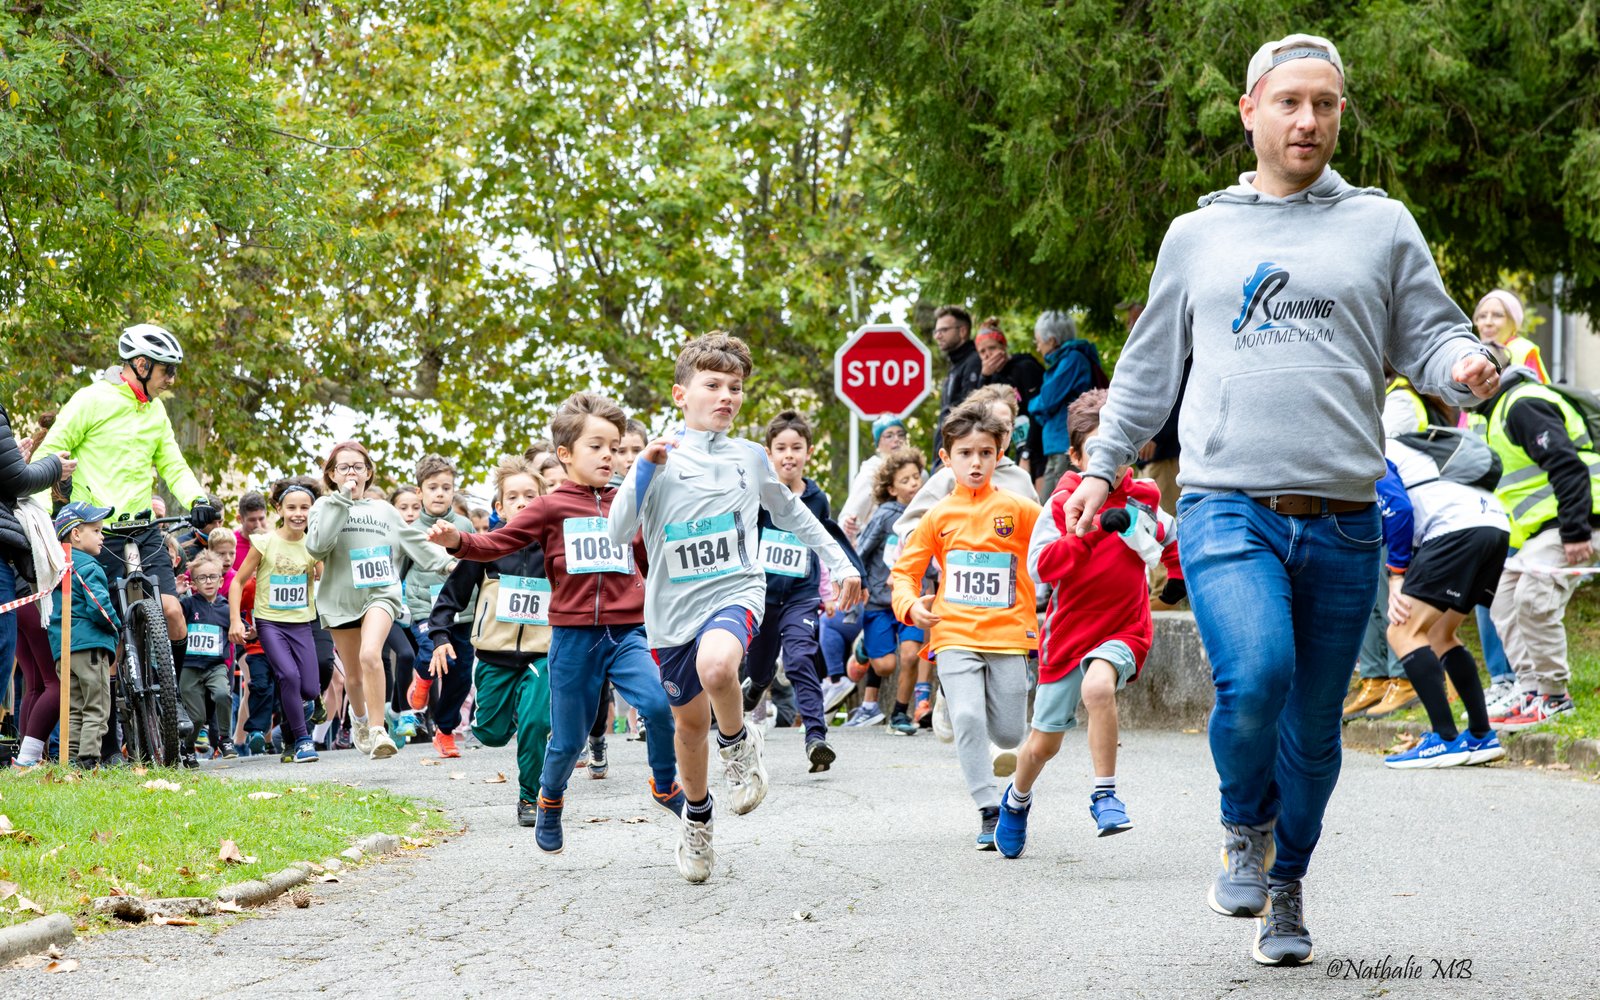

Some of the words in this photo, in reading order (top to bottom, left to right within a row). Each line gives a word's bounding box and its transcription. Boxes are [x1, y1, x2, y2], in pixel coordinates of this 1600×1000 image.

[1235, 327, 1335, 351] MONTMEYRAN
[847, 359, 920, 387] STOP
[675, 537, 730, 569] 1134
[765, 546, 801, 567] 1087
[356, 560, 390, 579] 1096
[693, 565, 719, 574] TOM
[953, 571, 1000, 595] 1135
[273, 587, 304, 602] 1092
[509, 593, 540, 614] 676
[188, 635, 214, 648] 1075
[1419, 743, 1447, 757] HOKA
